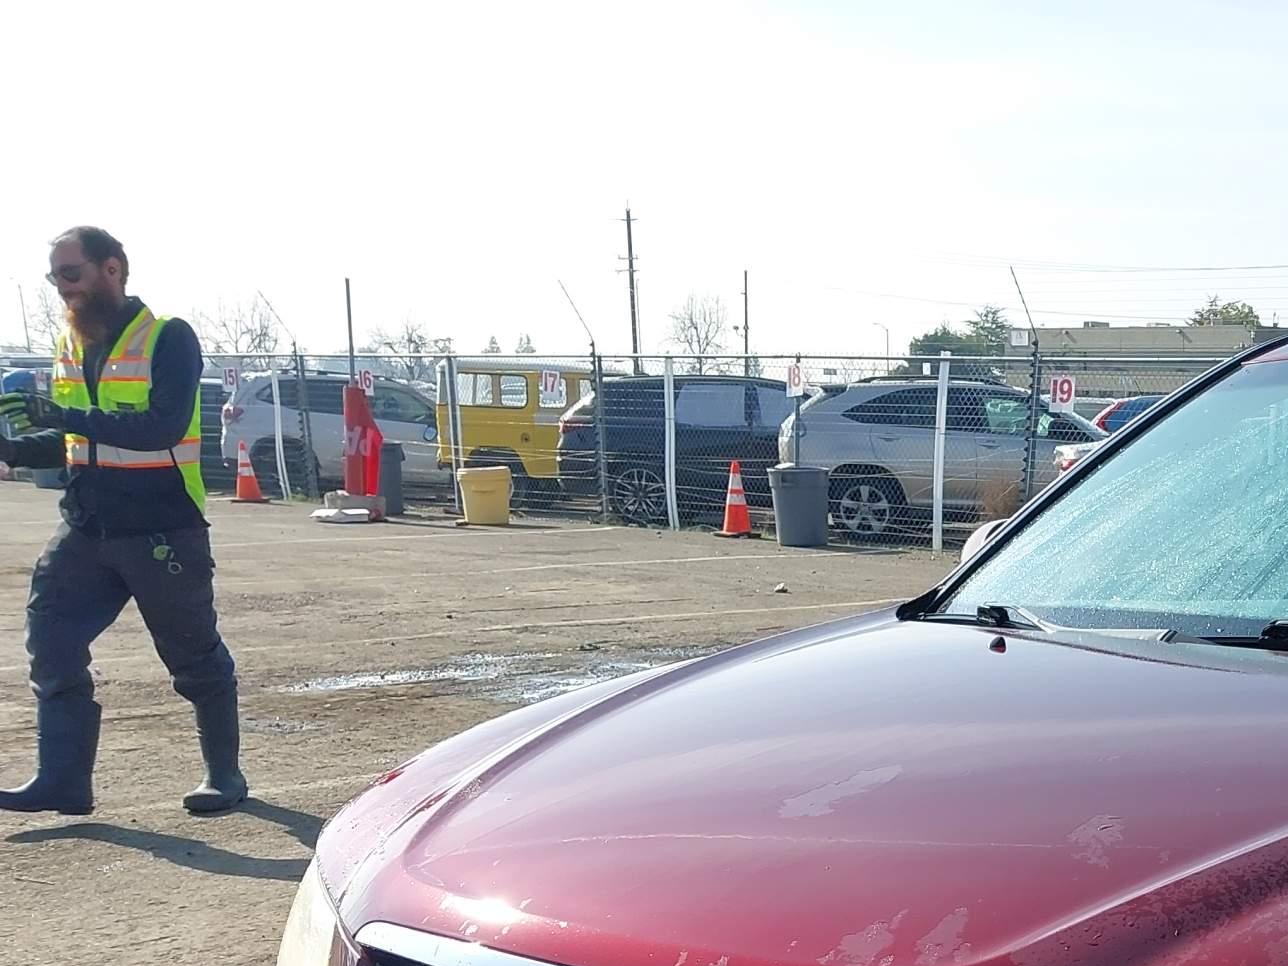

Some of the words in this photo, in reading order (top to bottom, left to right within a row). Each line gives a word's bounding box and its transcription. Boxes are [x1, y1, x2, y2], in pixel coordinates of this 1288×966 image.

[359, 370, 372, 389] 16
[544, 372, 558, 392] 17
[788, 366, 801, 388] 18
[1052, 379, 1073, 403] 19
